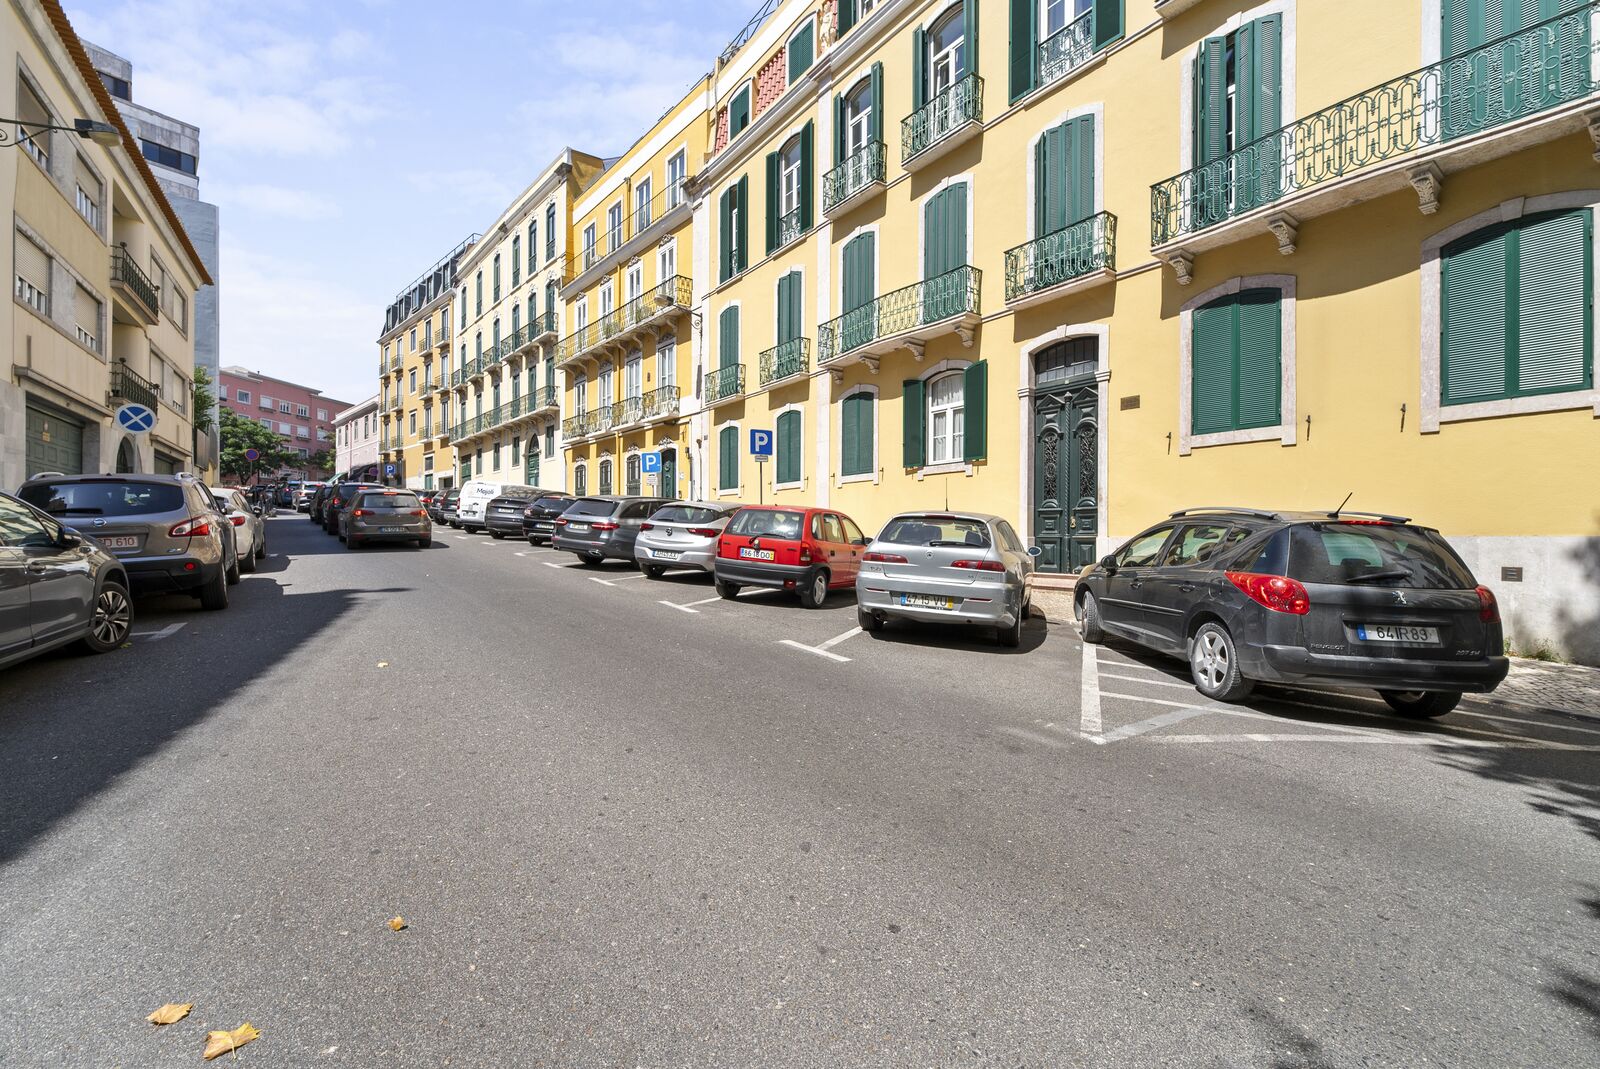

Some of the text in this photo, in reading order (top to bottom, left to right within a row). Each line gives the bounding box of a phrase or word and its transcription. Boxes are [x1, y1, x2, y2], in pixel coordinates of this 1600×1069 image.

[755, 432, 769, 452] P
[387, 465, 393, 473] P
[646, 455, 656, 471] P
[116, 537, 135, 546] 610
